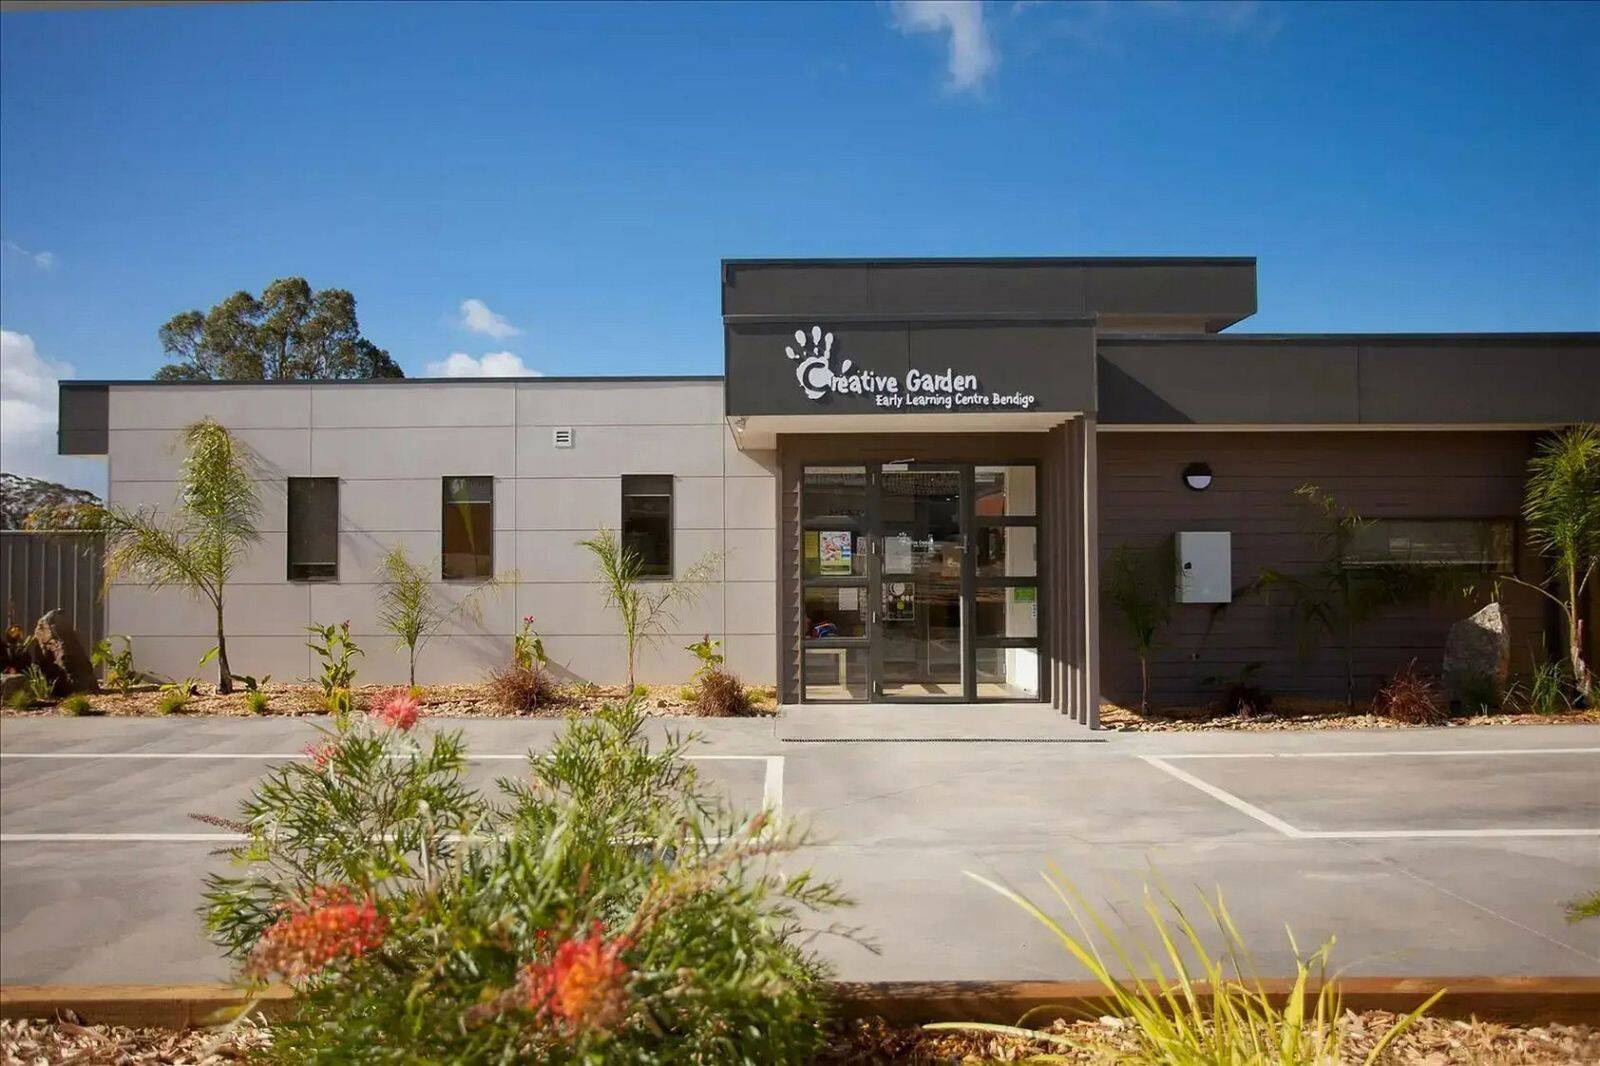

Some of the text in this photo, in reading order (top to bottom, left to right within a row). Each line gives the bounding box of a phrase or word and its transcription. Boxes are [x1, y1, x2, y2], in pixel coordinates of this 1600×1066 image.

[799, 360, 977, 395] Creative Garden
[876, 393, 1035, 408] Early Learning Centre Bendigo
